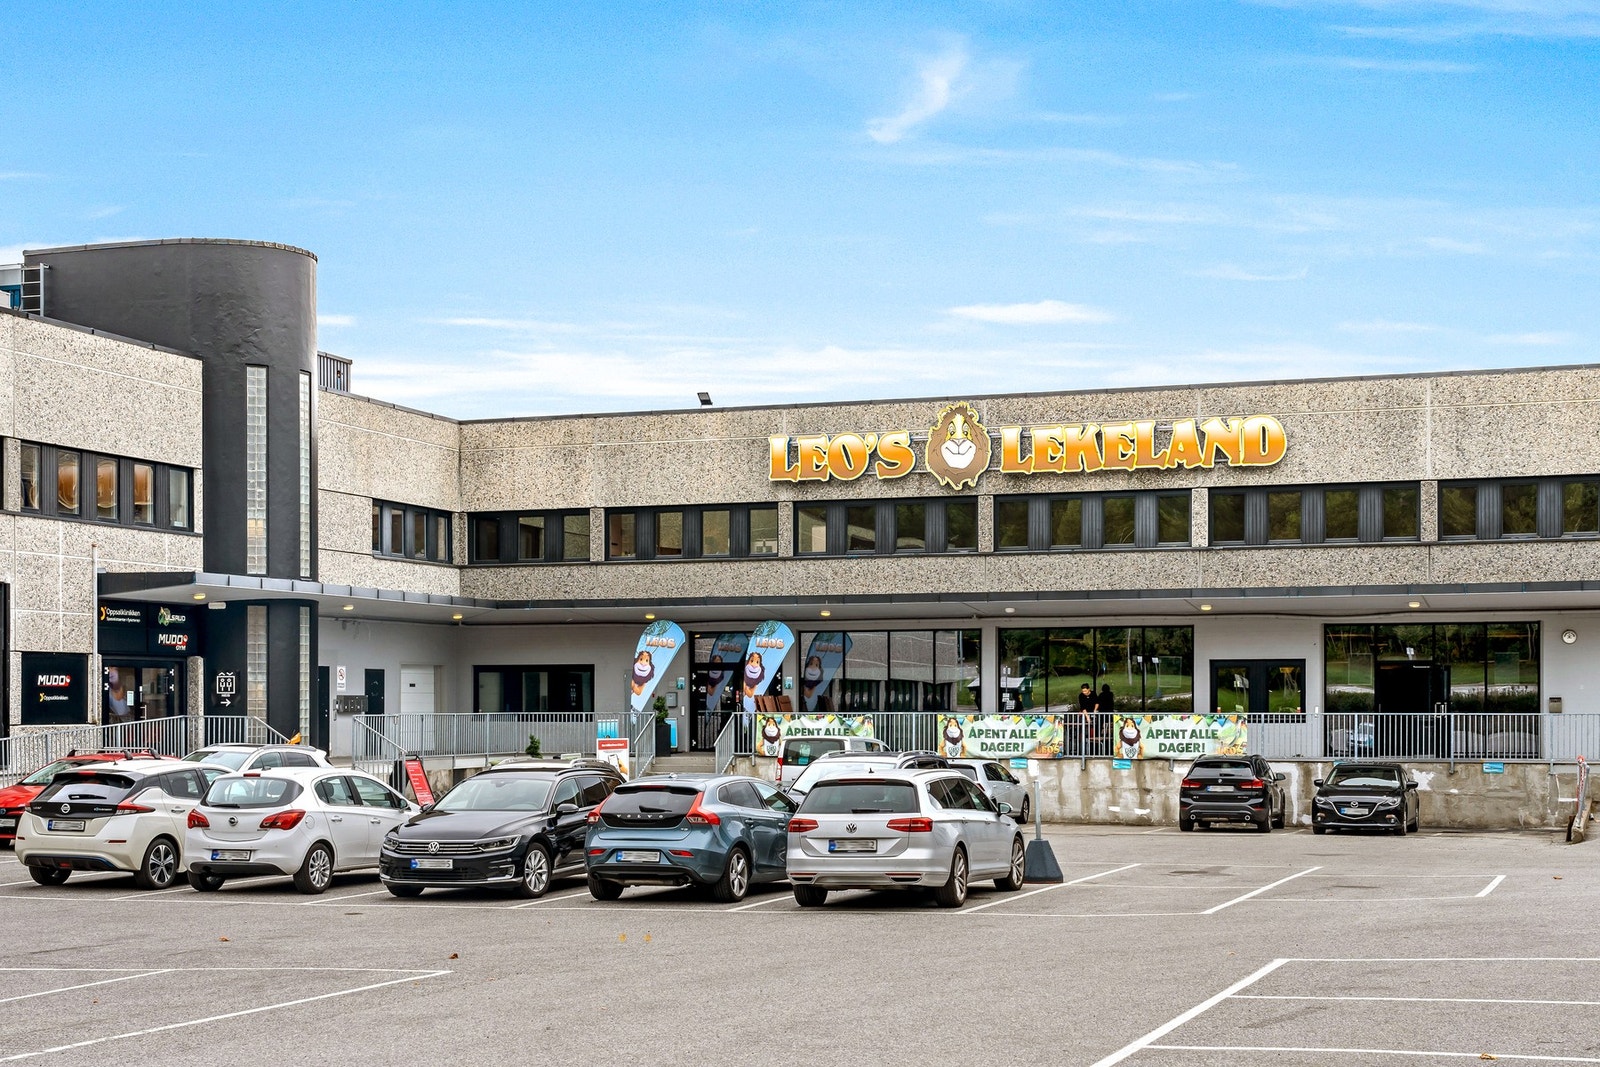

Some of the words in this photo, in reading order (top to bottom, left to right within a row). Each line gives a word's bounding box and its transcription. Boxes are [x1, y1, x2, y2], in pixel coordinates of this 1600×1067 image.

[768, 429, 916, 482] LEO'S
[1000, 414, 1289, 476] LEKELAND
[158, 633, 183, 645] MUDO
[37, 674, 66, 686] MUDO
[824, 727, 850, 737] ALLE
[968, 727, 1007, 739] ÅPENT
[1009, 729, 1037, 739] ALLE
[1146, 727, 1187, 740] ÅPENT
[1189, 729, 1219, 739] ALLE
[980, 742, 1024, 752] DAGER!
[1158, 743, 1205, 753] DAGER!
